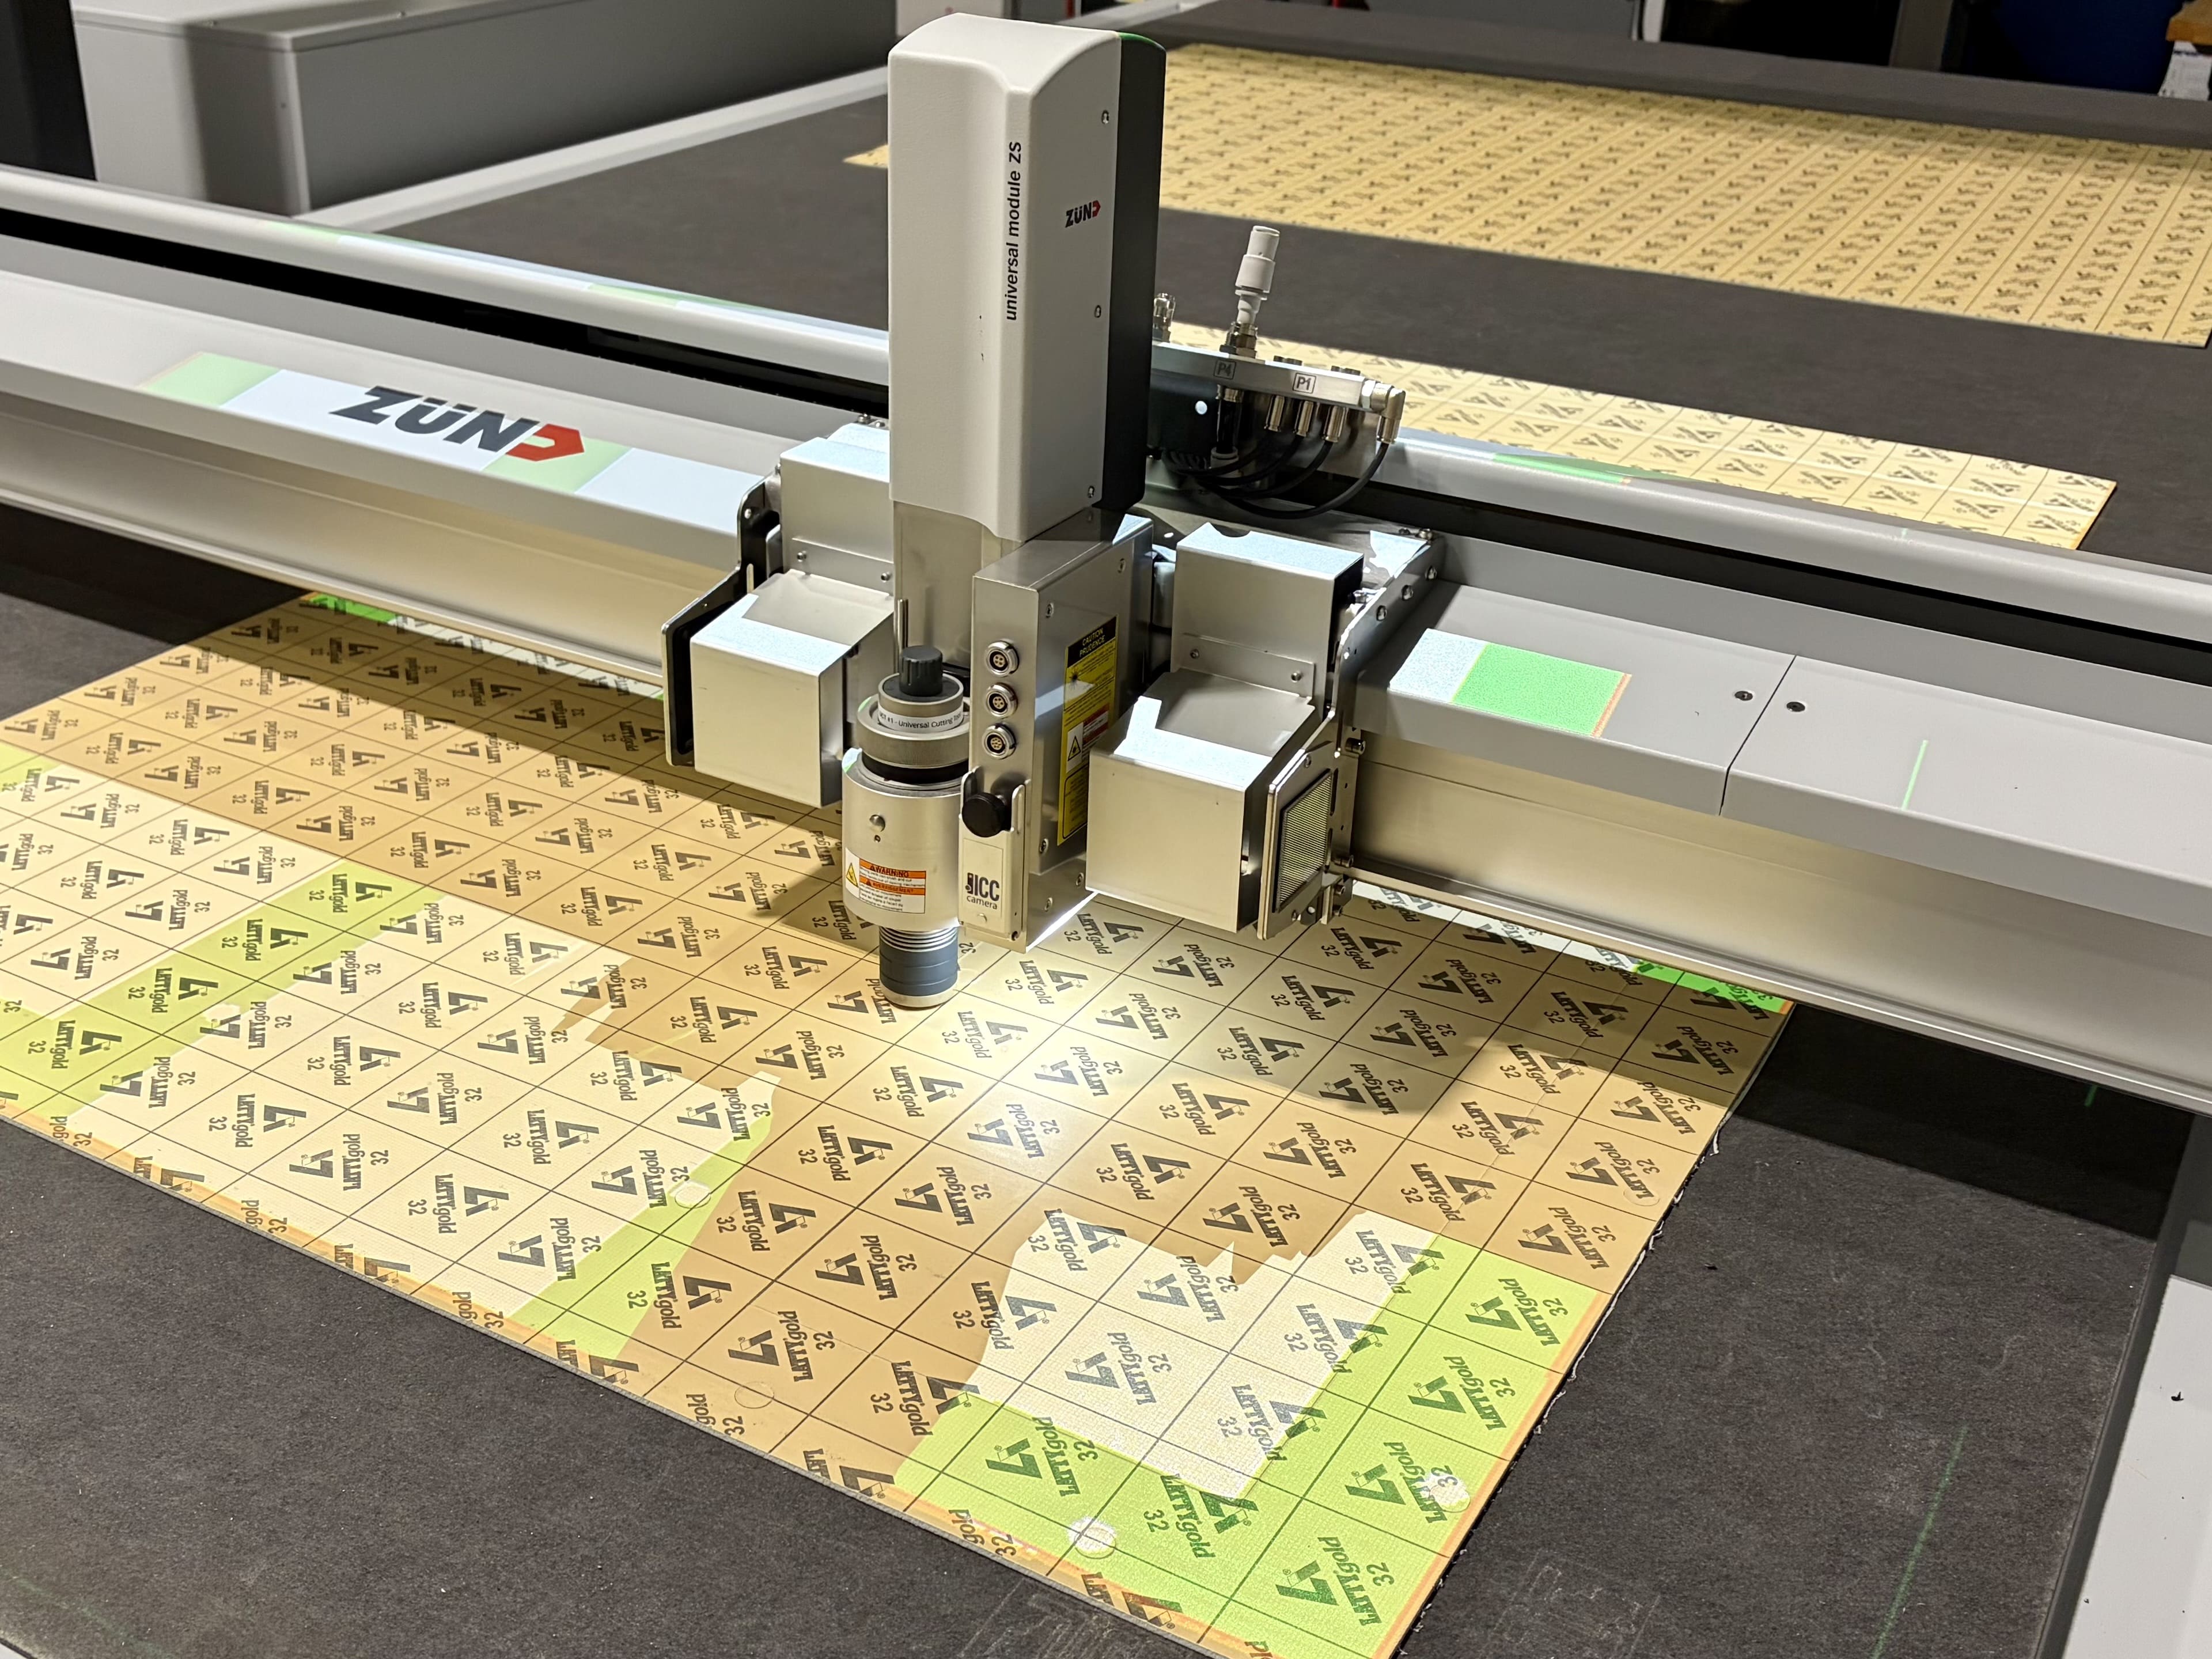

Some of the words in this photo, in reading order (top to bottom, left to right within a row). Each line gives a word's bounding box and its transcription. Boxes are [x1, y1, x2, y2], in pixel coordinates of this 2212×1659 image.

[1007, 171, 1021, 237] module
[1005, 242, 1019, 320] universal
[1218, 362, 1232, 376] P4
[1297, 376, 1311, 391] P1
[1082, 627, 1104, 646] CAUTION
[1080, 635, 1105, 657] PRUDENCE
[899, 720, 929, 728] Universal
[931, 718, 953, 728] Cutting
[279, 857, 296, 868] 32
[524, 869, 541, 881] 32
[875, 865, 909, 877] WARNING
[771, 882, 789, 894] 32
[967, 895, 997, 910] camera
[221, 935, 238, 949] 32
[1063, 930, 1082, 942] 32
[1320, 944, 1340, 957] 32
[743, 963, 762, 976] 32
[1215, 956, 1236, 969] 32
[630, 976, 648, 990] 32
[1004, 978, 1024, 991] 32
[1480, 972, 1502, 985] 32
[398, 1001, 416, 1015] 32
[1270, 994, 1291, 1007] 32
[1161, 1006, 1181, 1020] 32
[1543, 1010, 1566, 1024] 32
[274, 1014, 292, 1029] 32
[669, 1015, 688, 1029] 32
[941, 1030, 961, 1045] 32
[1435, 1023, 1457, 1037] 32
[26, 1040, 47, 1055] 32
[825, 1044, 845, 1059] 32
[1217, 1047, 1238, 1062] 32
[1715, 1040, 1740, 1055] 32
[1102, 1060, 1123, 1075] 32
[1499, 1065, 1522, 1080] 32
[589, 1071, 608, 1086] 32
[1387, 1078, 1409, 1093] 32
[464, 1087, 483, 1103] 32
[872, 1086, 893, 1102] 32
[751, 1103, 771, 1118] 32
[1158, 1104, 1180, 1120] 32
[1677, 1097, 1702, 1112] 32
[208, 1116, 228, 1132] 32
[1039, 1119, 1060, 1135] 32
[1451, 1123, 1475, 1139] 32
[502, 1132, 522, 1149] 32
[1334, 1138, 1357, 1154] 32
[797, 1148, 819, 1165] 32
[669, 1166, 690, 1183] 32
[1095, 1166, 1118, 1183] 32
[1635, 1158, 1661, 1175] 32
[970, 1183, 993, 1200] 32
[1400, 1187, 1424, 1204] 32
[407, 1199, 427, 1217] 32
[1277, 1203, 1301, 1221] 32
[715, 1215, 737, 1234] 32
[1590, 1225, 1616, 1243] 32
[580, 1235, 601, 1253] 32
[1027, 1234, 1050, 1253] 32
[895, 1253, 918, 1272] 32
[1344, 1256, 1369, 1275] 32
[1215, 1275, 1240, 1294] 32
[626, 1289, 648, 1309] 32
[1542, 1297, 1569, 1317] 32
[952, 1309, 975, 1330] 32
[813, 1330, 836, 1351] 32
[1283, 1332, 1309, 1353] 32
[1147, 1353, 1172, 1374] 32
[1488, 1377, 1516, 1399] 32
[870, 1392, 895, 1414] 32
[1216, 1416, 1243, 1438] 32
[1073, 1440, 1099, 1462] 32
[1430, 1465, 1458, 1488] 32
[1142, 1508, 1169, 1533] 32
[1365, 1562, 1395, 1588] 32
